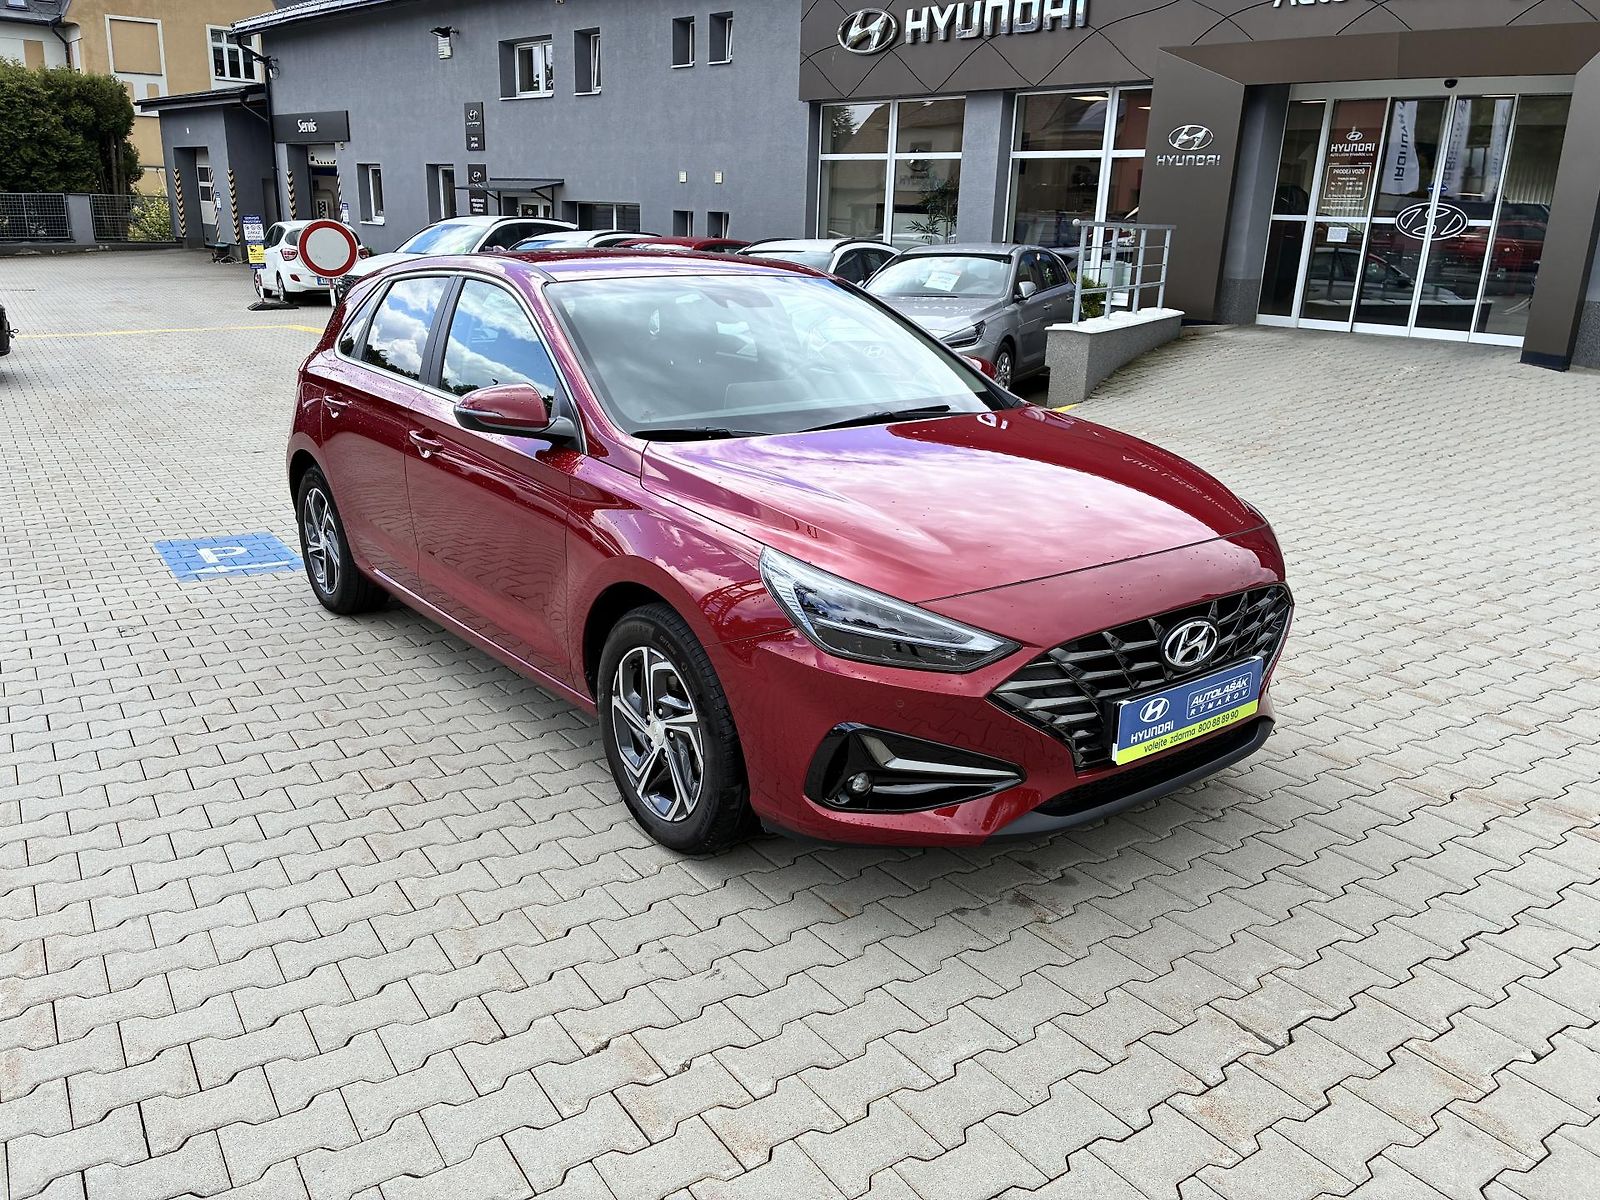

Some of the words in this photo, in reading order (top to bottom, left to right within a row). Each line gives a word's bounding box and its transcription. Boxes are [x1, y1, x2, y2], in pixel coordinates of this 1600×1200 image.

[905, 0, 1089, 44] HYUNDAI
[297, 118, 317, 133] Servis
[1330, 143, 1375, 152] HYUNDAI
[1156, 154, 1221, 166] HYUNDAI
[1130, 720, 1174, 744] HYUNDAI
[1144, 737, 1168, 753] volejte
[1169, 729, 1196, 744] zdarma
[1197, 721, 1211, 733] 800
[1211, 717, 1221, 728] 88
[1220, 713, 1230, 724] 89
[1229, 709, 1239, 720] 90
